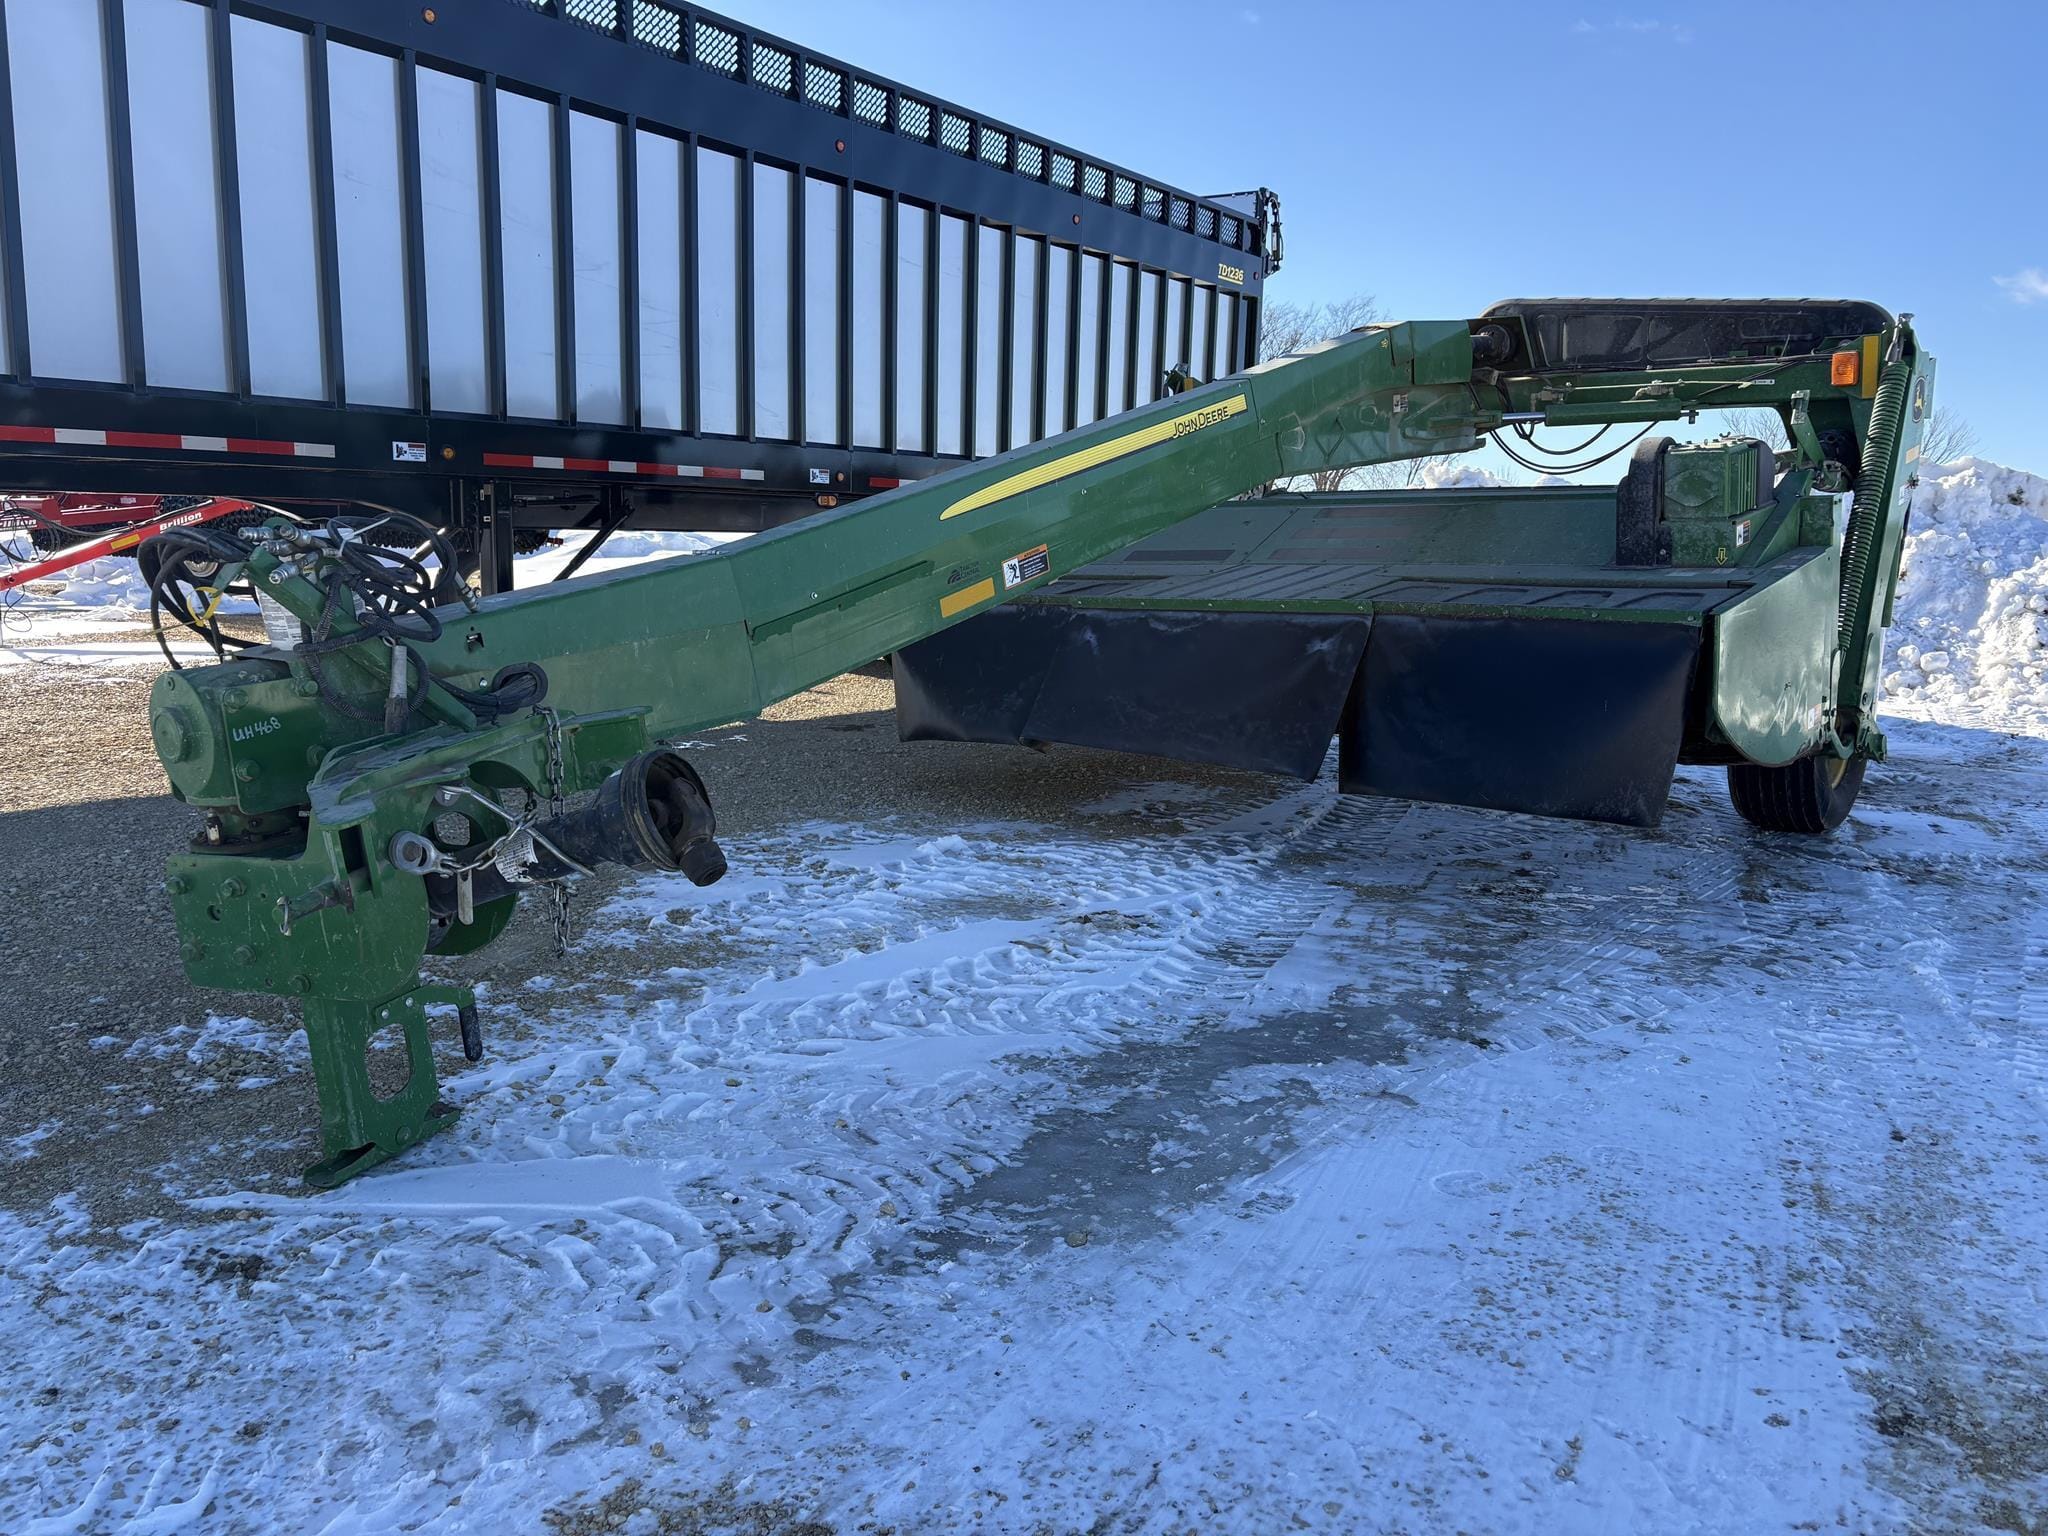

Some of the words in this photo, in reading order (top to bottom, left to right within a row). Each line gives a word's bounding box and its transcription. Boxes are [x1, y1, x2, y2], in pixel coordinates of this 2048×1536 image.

[1218, 263, 1244, 281] TD1236
[1172, 416, 1198, 437] JOHN
[1197, 406, 1230, 427] DEERE
[159, 512, 202, 531] Brillion
